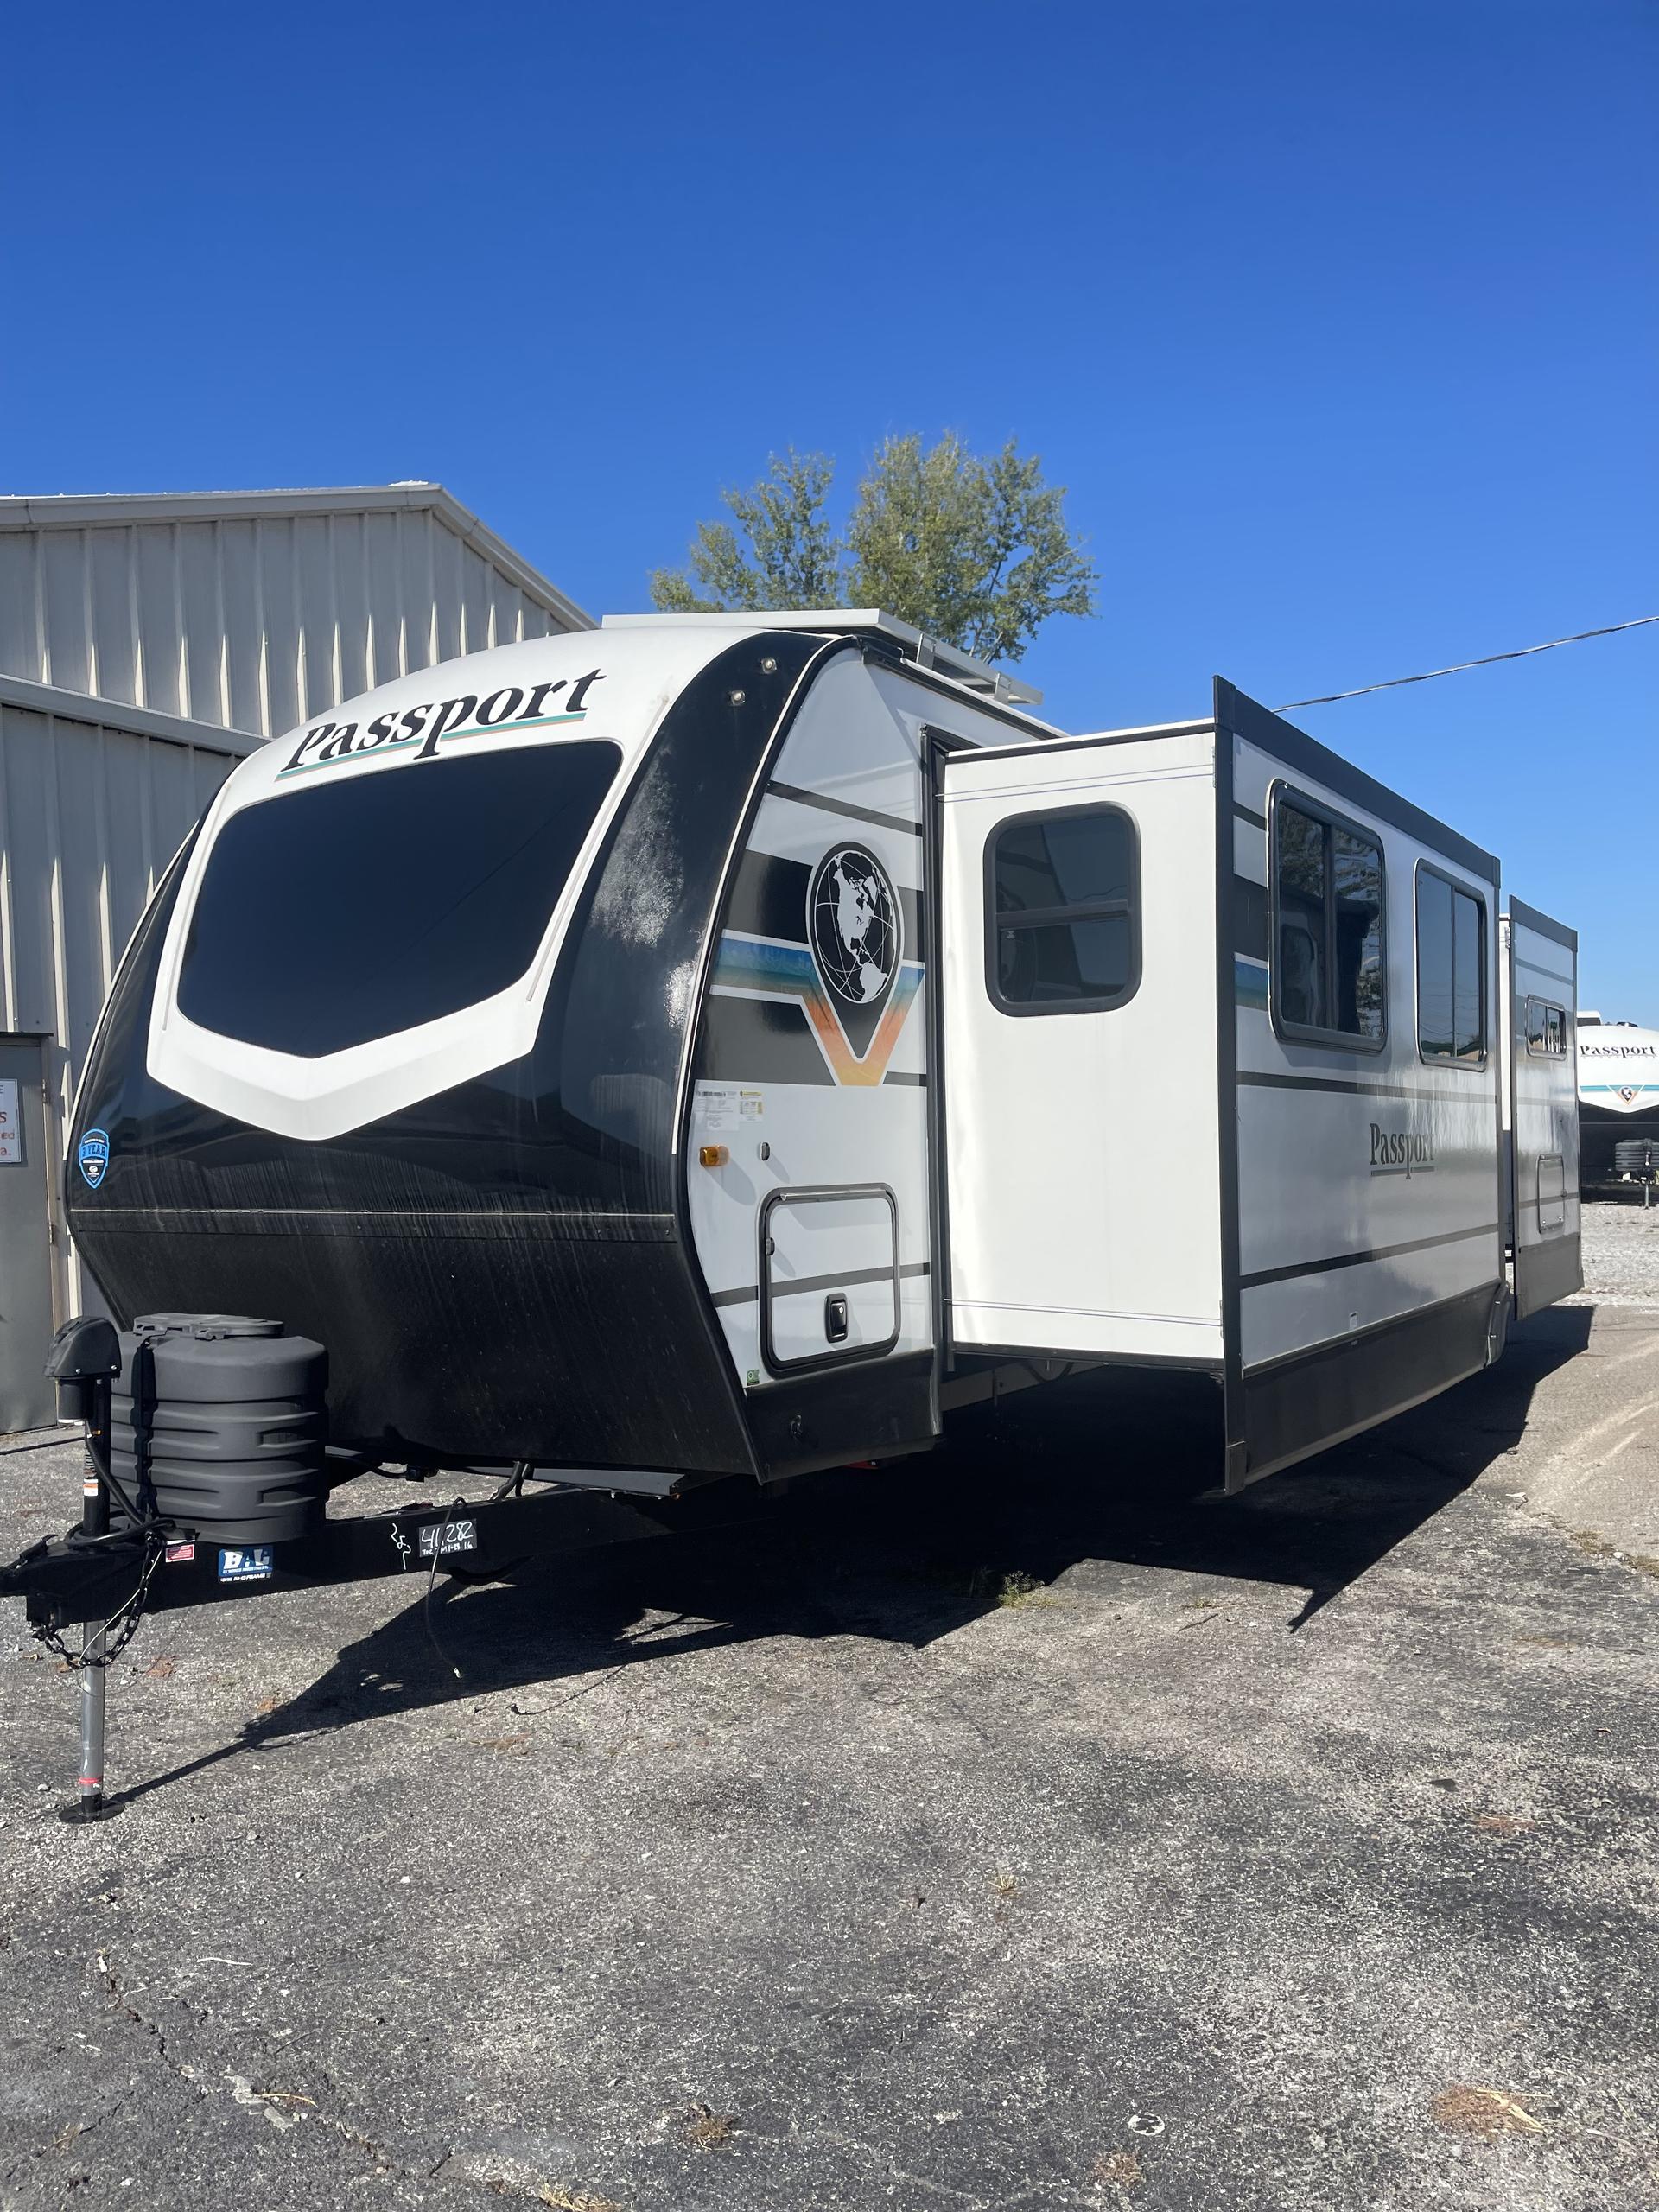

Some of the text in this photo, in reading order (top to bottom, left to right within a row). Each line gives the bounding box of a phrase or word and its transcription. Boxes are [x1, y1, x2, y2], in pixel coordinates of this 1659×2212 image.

[281, 668, 607, 772] Passport
[1580, 1045, 1656, 1058] Passport
[1370, 1123, 1434, 1179] Passport
